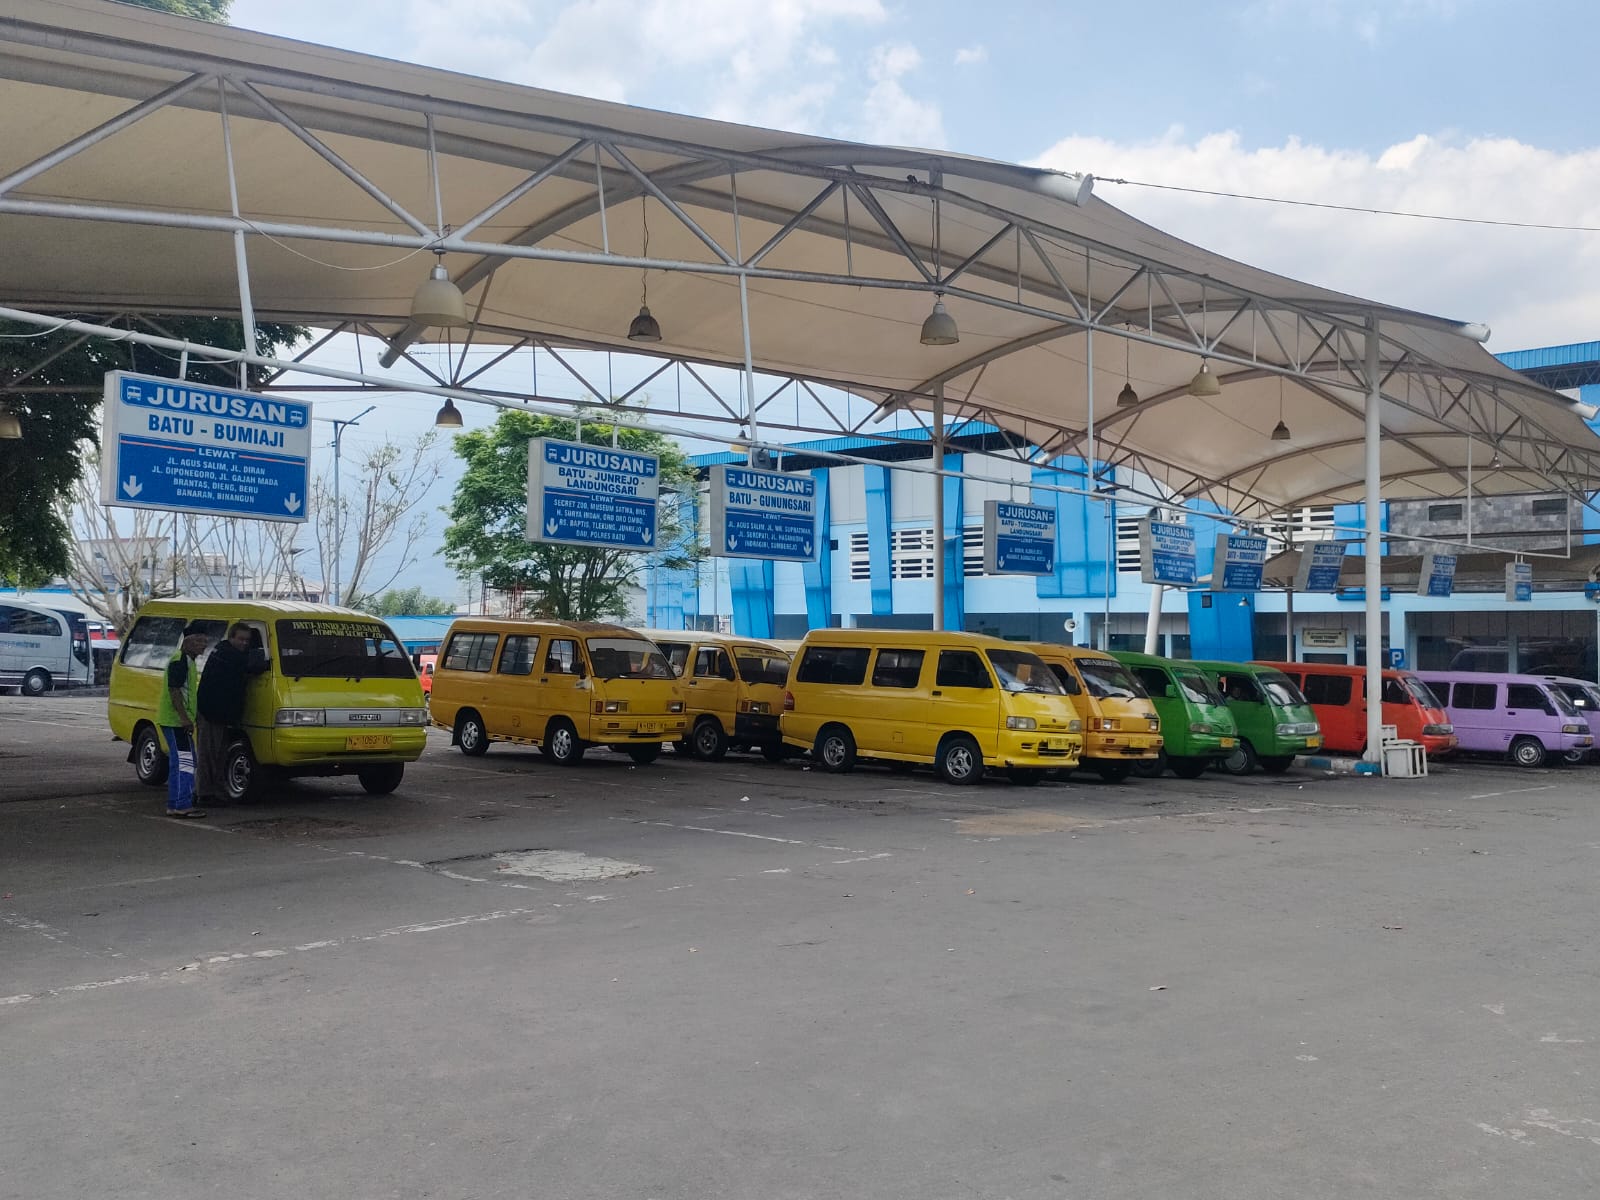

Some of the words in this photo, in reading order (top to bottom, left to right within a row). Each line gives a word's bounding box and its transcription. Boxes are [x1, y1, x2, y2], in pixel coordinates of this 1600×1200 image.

[148, 387, 286, 423] JURUSAN
[148, 414, 194, 436] BATU
[214, 423, 284, 448] BUMIAJI
[198, 448, 237, 460] LEWAT
[560, 448, 644, 474] JURUSAN
[167, 457, 178, 465] JL.
[180, 458, 201, 468] AGUS
[202, 461, 228, 472] SALIM,
[230, 464, 241, 473] JL.
[243, 466, 266, 476] DIRAN
[152, 466, 163, 474] JL.
[165, 466, 217, 480] DIPONEGORO,
[219, 472, 230, 481] JL.
[232, 474, 256, 484] GAJAH
[258, 477, 278, 486] MADA
[558, 466, 586, 479] BATU
[594, 472, 639, 486] JUNREJO
[738, 473, 804, 493] JURUSAN
[173, 478, 210, 489] BRANTAS,
[212, 482, 237, 492] DIENG,
[239, 484, 258, 494] BERU
[566, 478, 637, 495] LANDUNGSARI
[176, 488, 215, 500] BANARAN,
[217, 492, 254, 503] BINANGUN
[591, 494, 614, 503] LEWAT
[730, 492, 751, 505] BATU
[760, 495, 810, 512] GUNUNGSARI
[553, 499, 576, 507] SECRET
[590, 503, 614, 512] MUSEUM
[1006, 506, 1048, 521] JURUSAN
[1157, 525, 1190, 538] JURUSAN
[1232, 539, 1263, 550] JURUSAN
[1392, 652, 1401, 664] P
